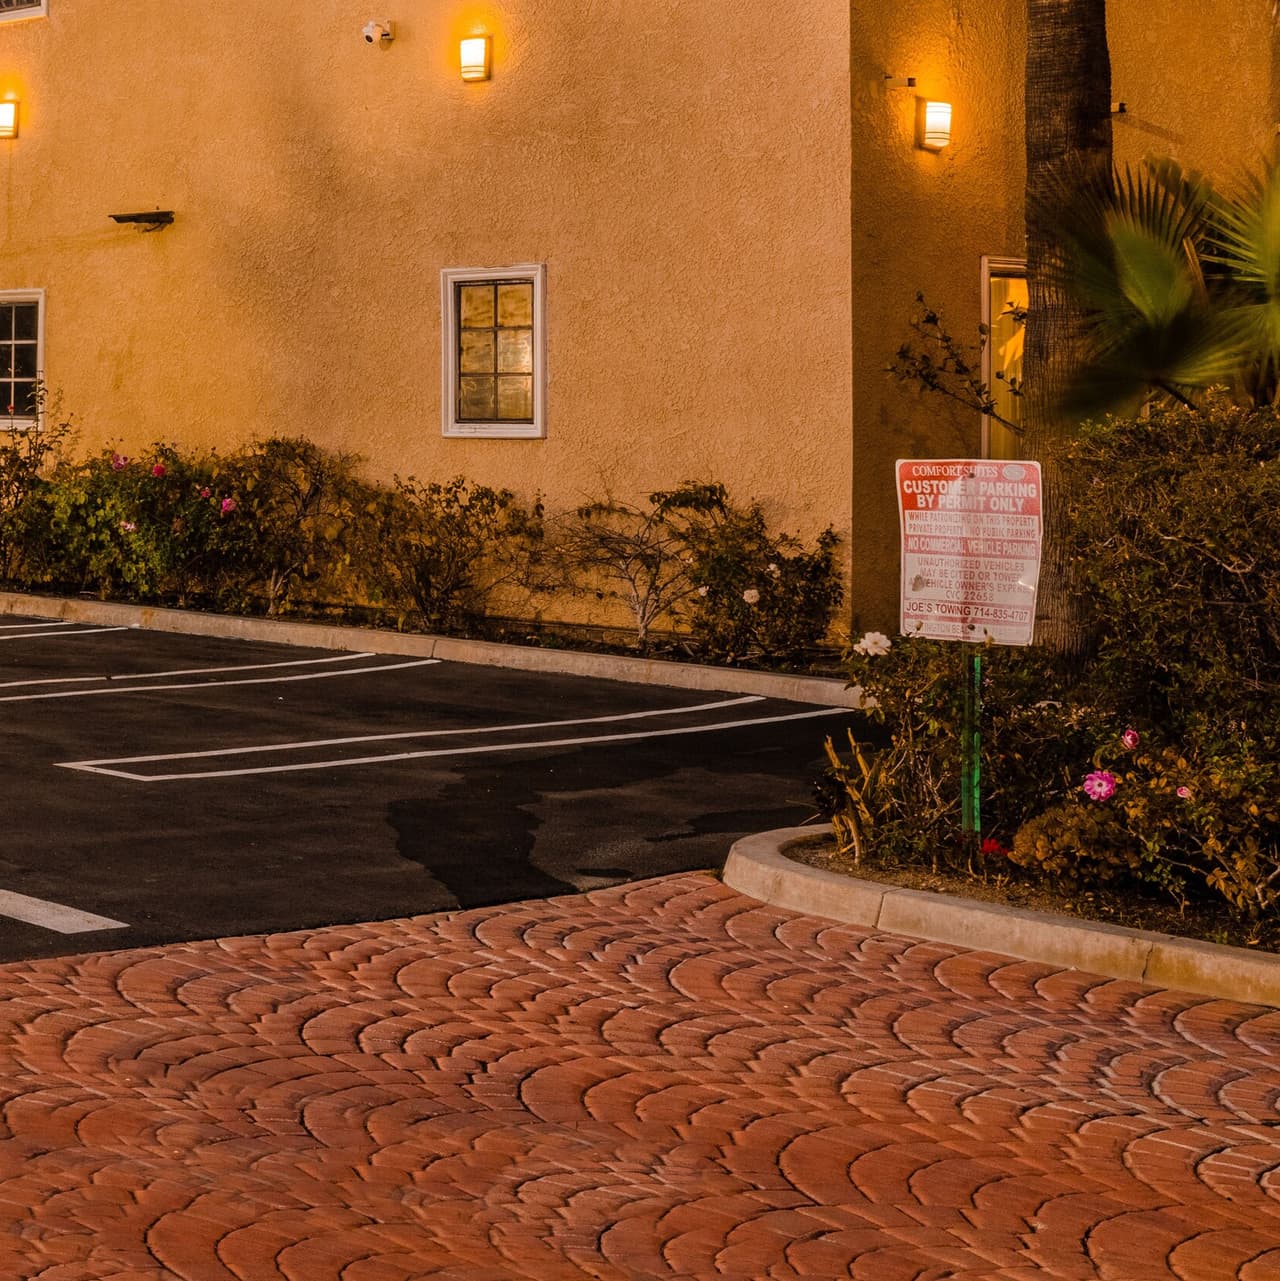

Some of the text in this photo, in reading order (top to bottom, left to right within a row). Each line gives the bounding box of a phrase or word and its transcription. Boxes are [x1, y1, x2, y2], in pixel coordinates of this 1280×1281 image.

[912, 465, 999, 478] COMFORT SUITES
[903, 480, 1037, 497] CUSTOMER PARKING
[917, 494, 1025, 511] BY PERMIT ONLY
[908, 512, 928, 521] WHILE
[1003, 516, 1035, 526] PROPERTY
[908, 524, 933, 533] PRIVATE
[935, 525, 963, 535] PROPERTY
[983, 527, 1005, 537] PUBLIC
[1007, 528, 1036, 538] PARKING
[908, 538, 1036, 557] NO COMMERCIAL VEHICLE PARKING
[918, 557, 1025, 572] UNAUTHORIZED VEHICLES
[920, 567, 936, 577] MAY
[939, 568, 949, 578] BE
[950, 569, 976, 580] CITED
[978, 571, 990, 581] OR
[955, 580, 994, 591] OWNER'S
[997, 583, 1031, 595] EXPEN
[945, 590, 994, 602] CVC 22658
[906, 601, 1029, 620] JOE'S TOWING 714-835-4707
[952, 624, 974, 635] BEAC
